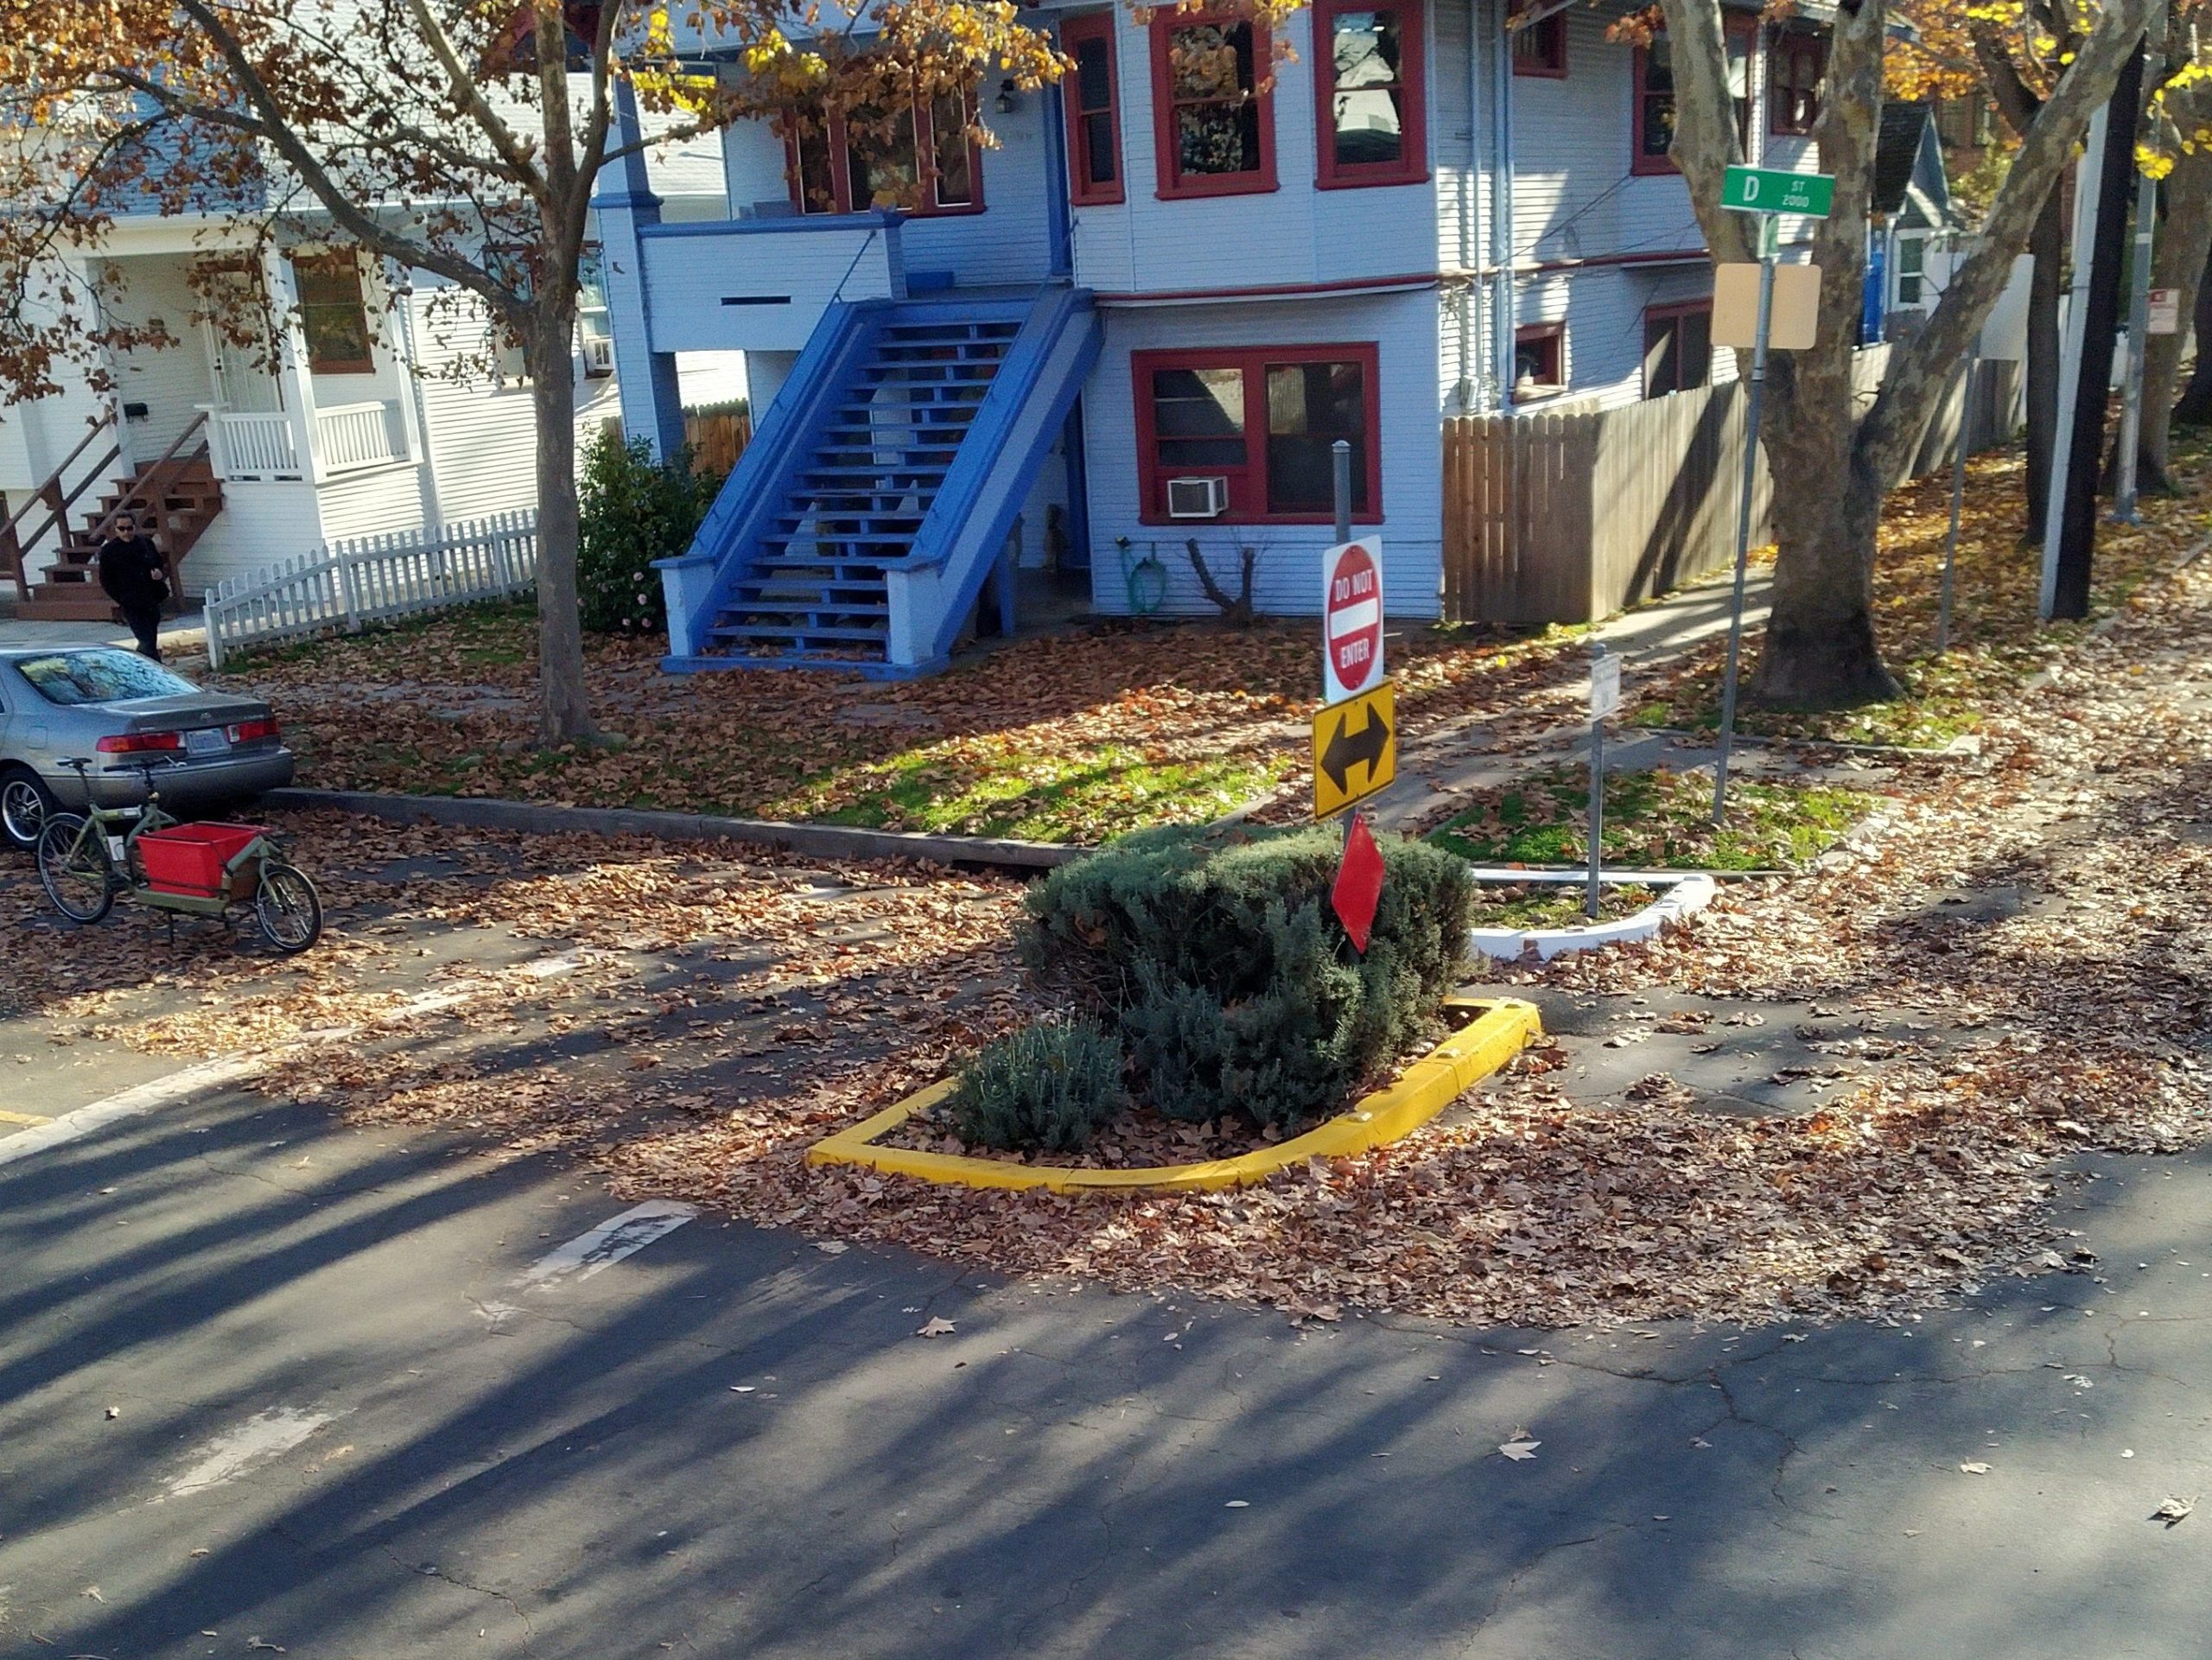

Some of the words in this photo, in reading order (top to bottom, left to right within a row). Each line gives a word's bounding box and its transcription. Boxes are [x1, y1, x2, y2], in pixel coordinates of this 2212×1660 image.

[1743, 175, 1760, 201] D
[1791, 181, 1806, 193] ST
[1335, 577, 1350, 601] DO
[1352, 569, 1373, 595] NOT
[1341, 638, 1370, 669] ENTER
